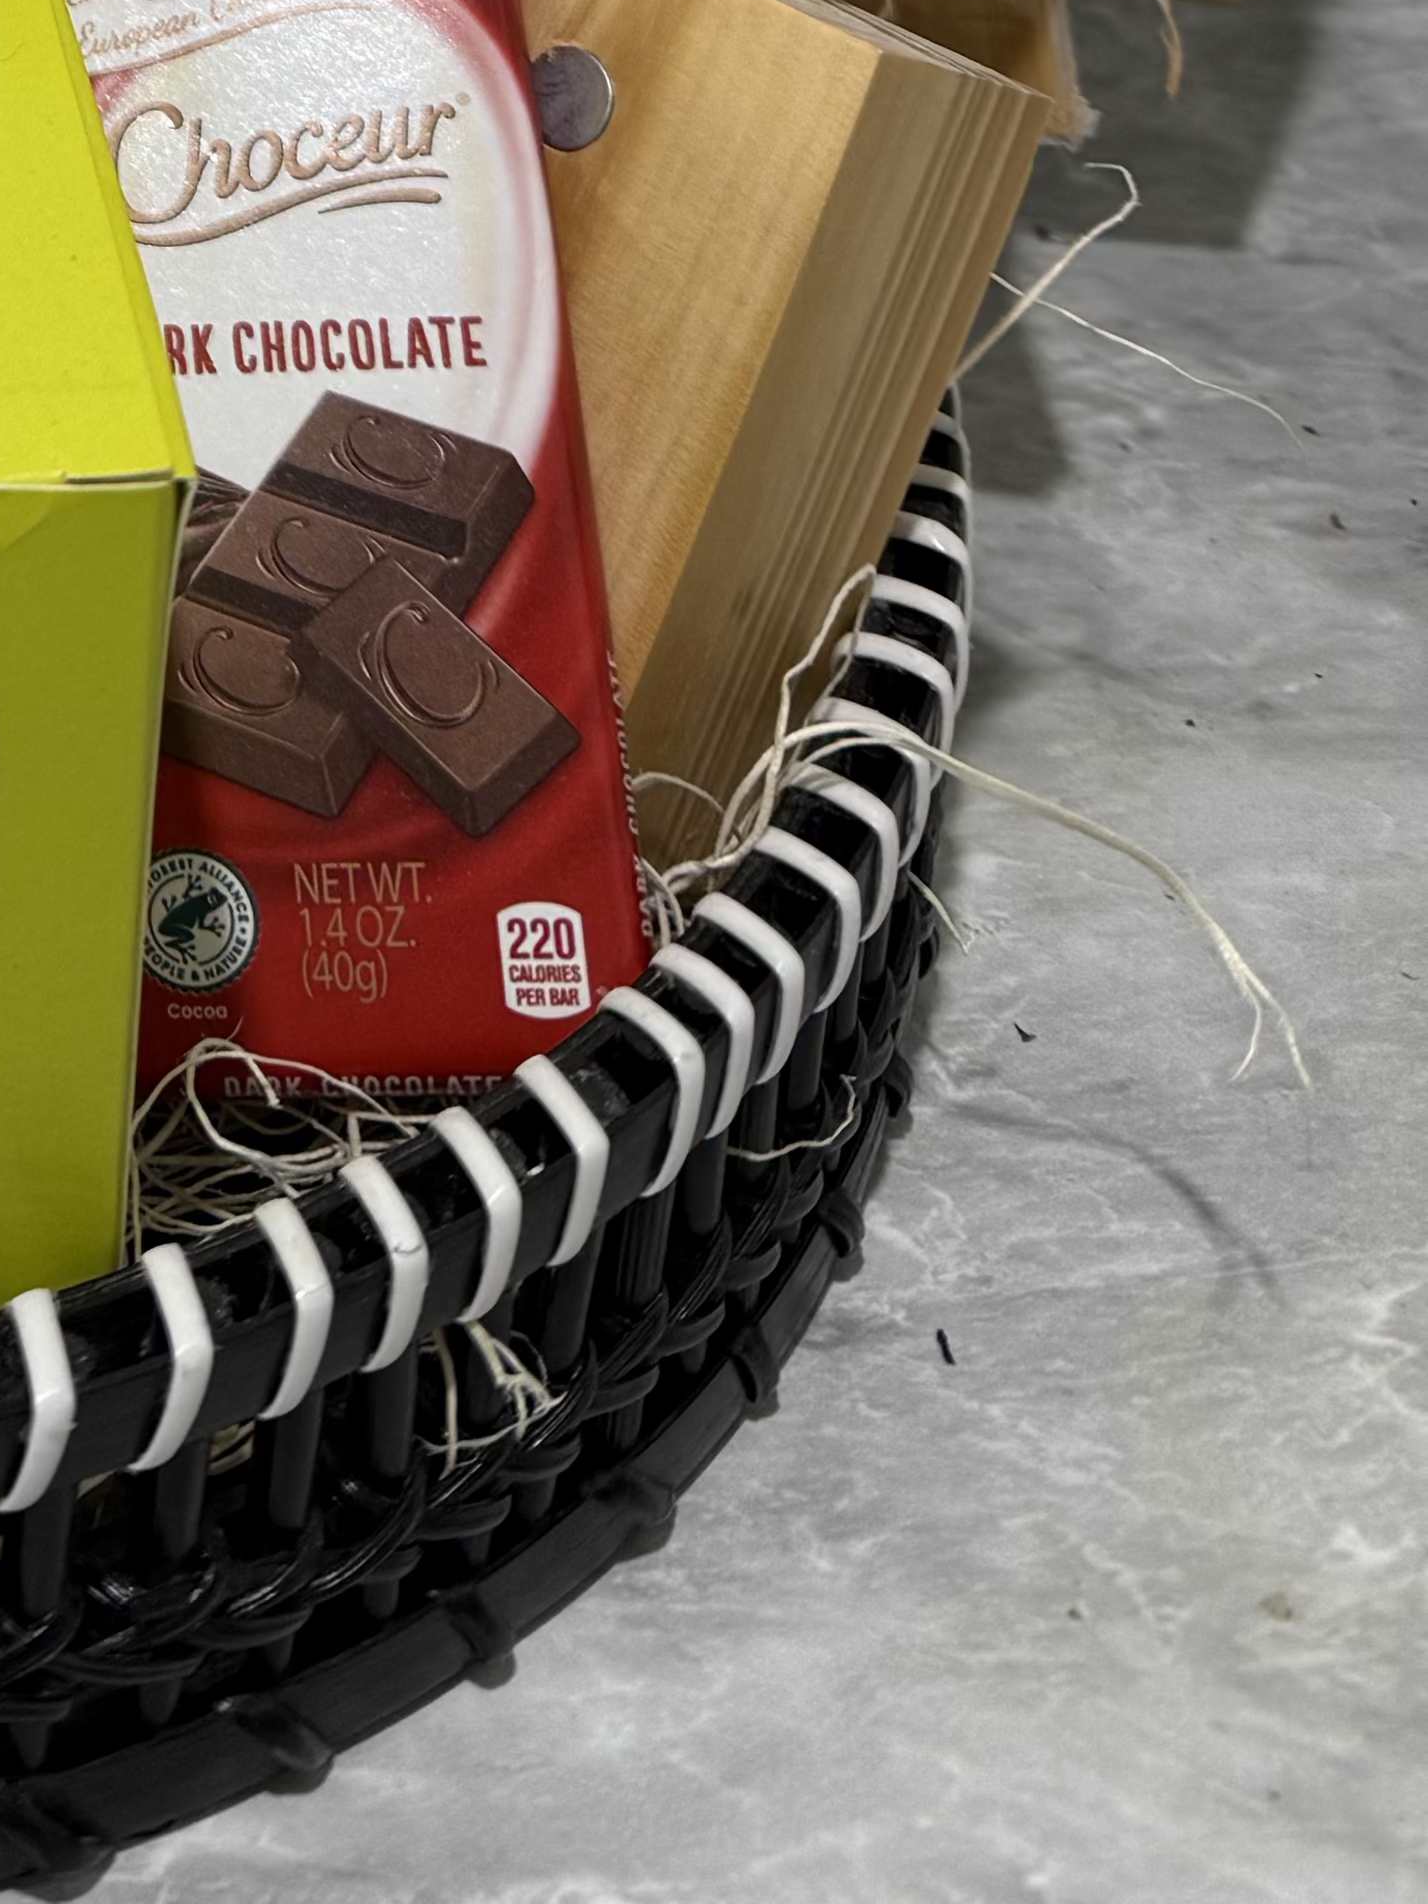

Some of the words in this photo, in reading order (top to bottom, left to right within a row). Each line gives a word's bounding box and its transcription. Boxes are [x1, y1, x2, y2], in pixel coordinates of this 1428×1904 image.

[166, 322, 218, 375] RK
[232, 314, 488, 373] CHOCOLATE
[294, 861, 361, 904] NET
[367, 861, 432, 903] WT.
[299, 907, 348, 947] 1.4
[356, 905, 416, 947] OZ.
[507, 917, 576, 960] 220
[302, 948, 388, 1004] (40g)
[508, 964, 582, 983] CALORIES
[167, 1003, 229, 1020] Cocoa
[515, 987, 546, 1006] PER
[549, 987, 580, 1006] BAR
